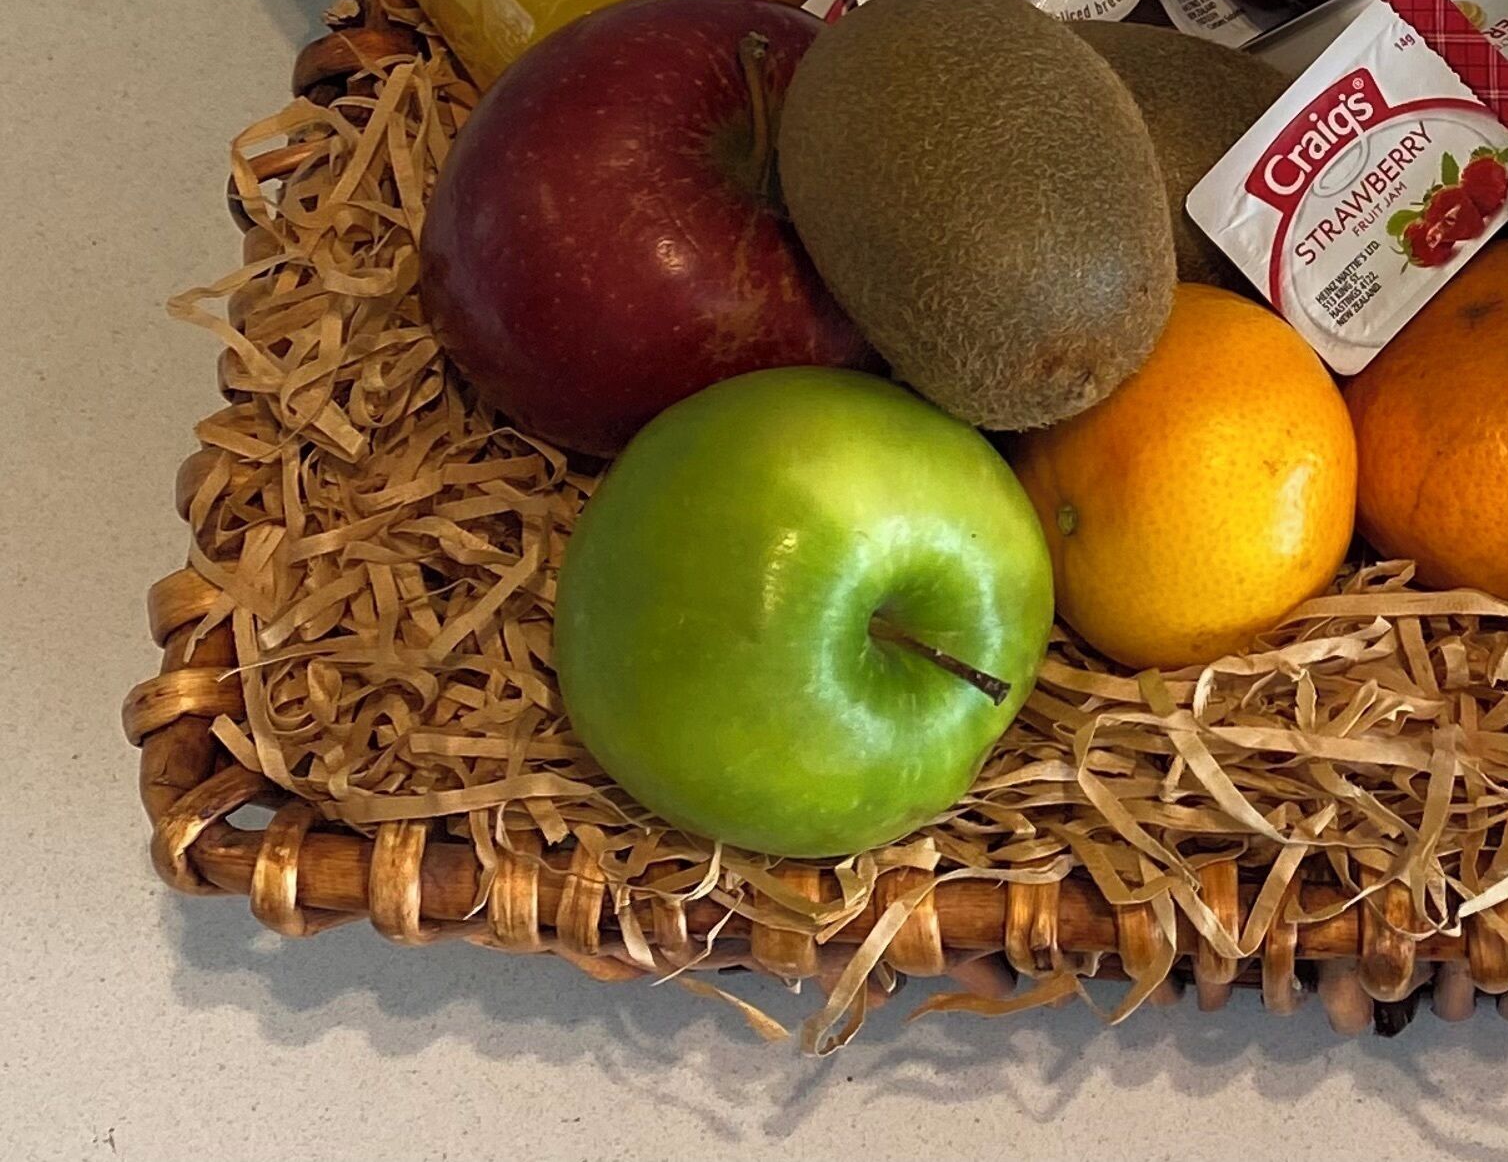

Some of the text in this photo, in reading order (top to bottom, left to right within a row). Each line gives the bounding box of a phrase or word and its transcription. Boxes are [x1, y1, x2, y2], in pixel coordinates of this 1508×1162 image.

[1263, 92, 1374, 196] Craig's
[1295, 121, 1432, 265] STRAWBERRY
[1352, 181, 1407, 237] FRUIT JAM
[1315, 277, 1339, 304] HEINZ
